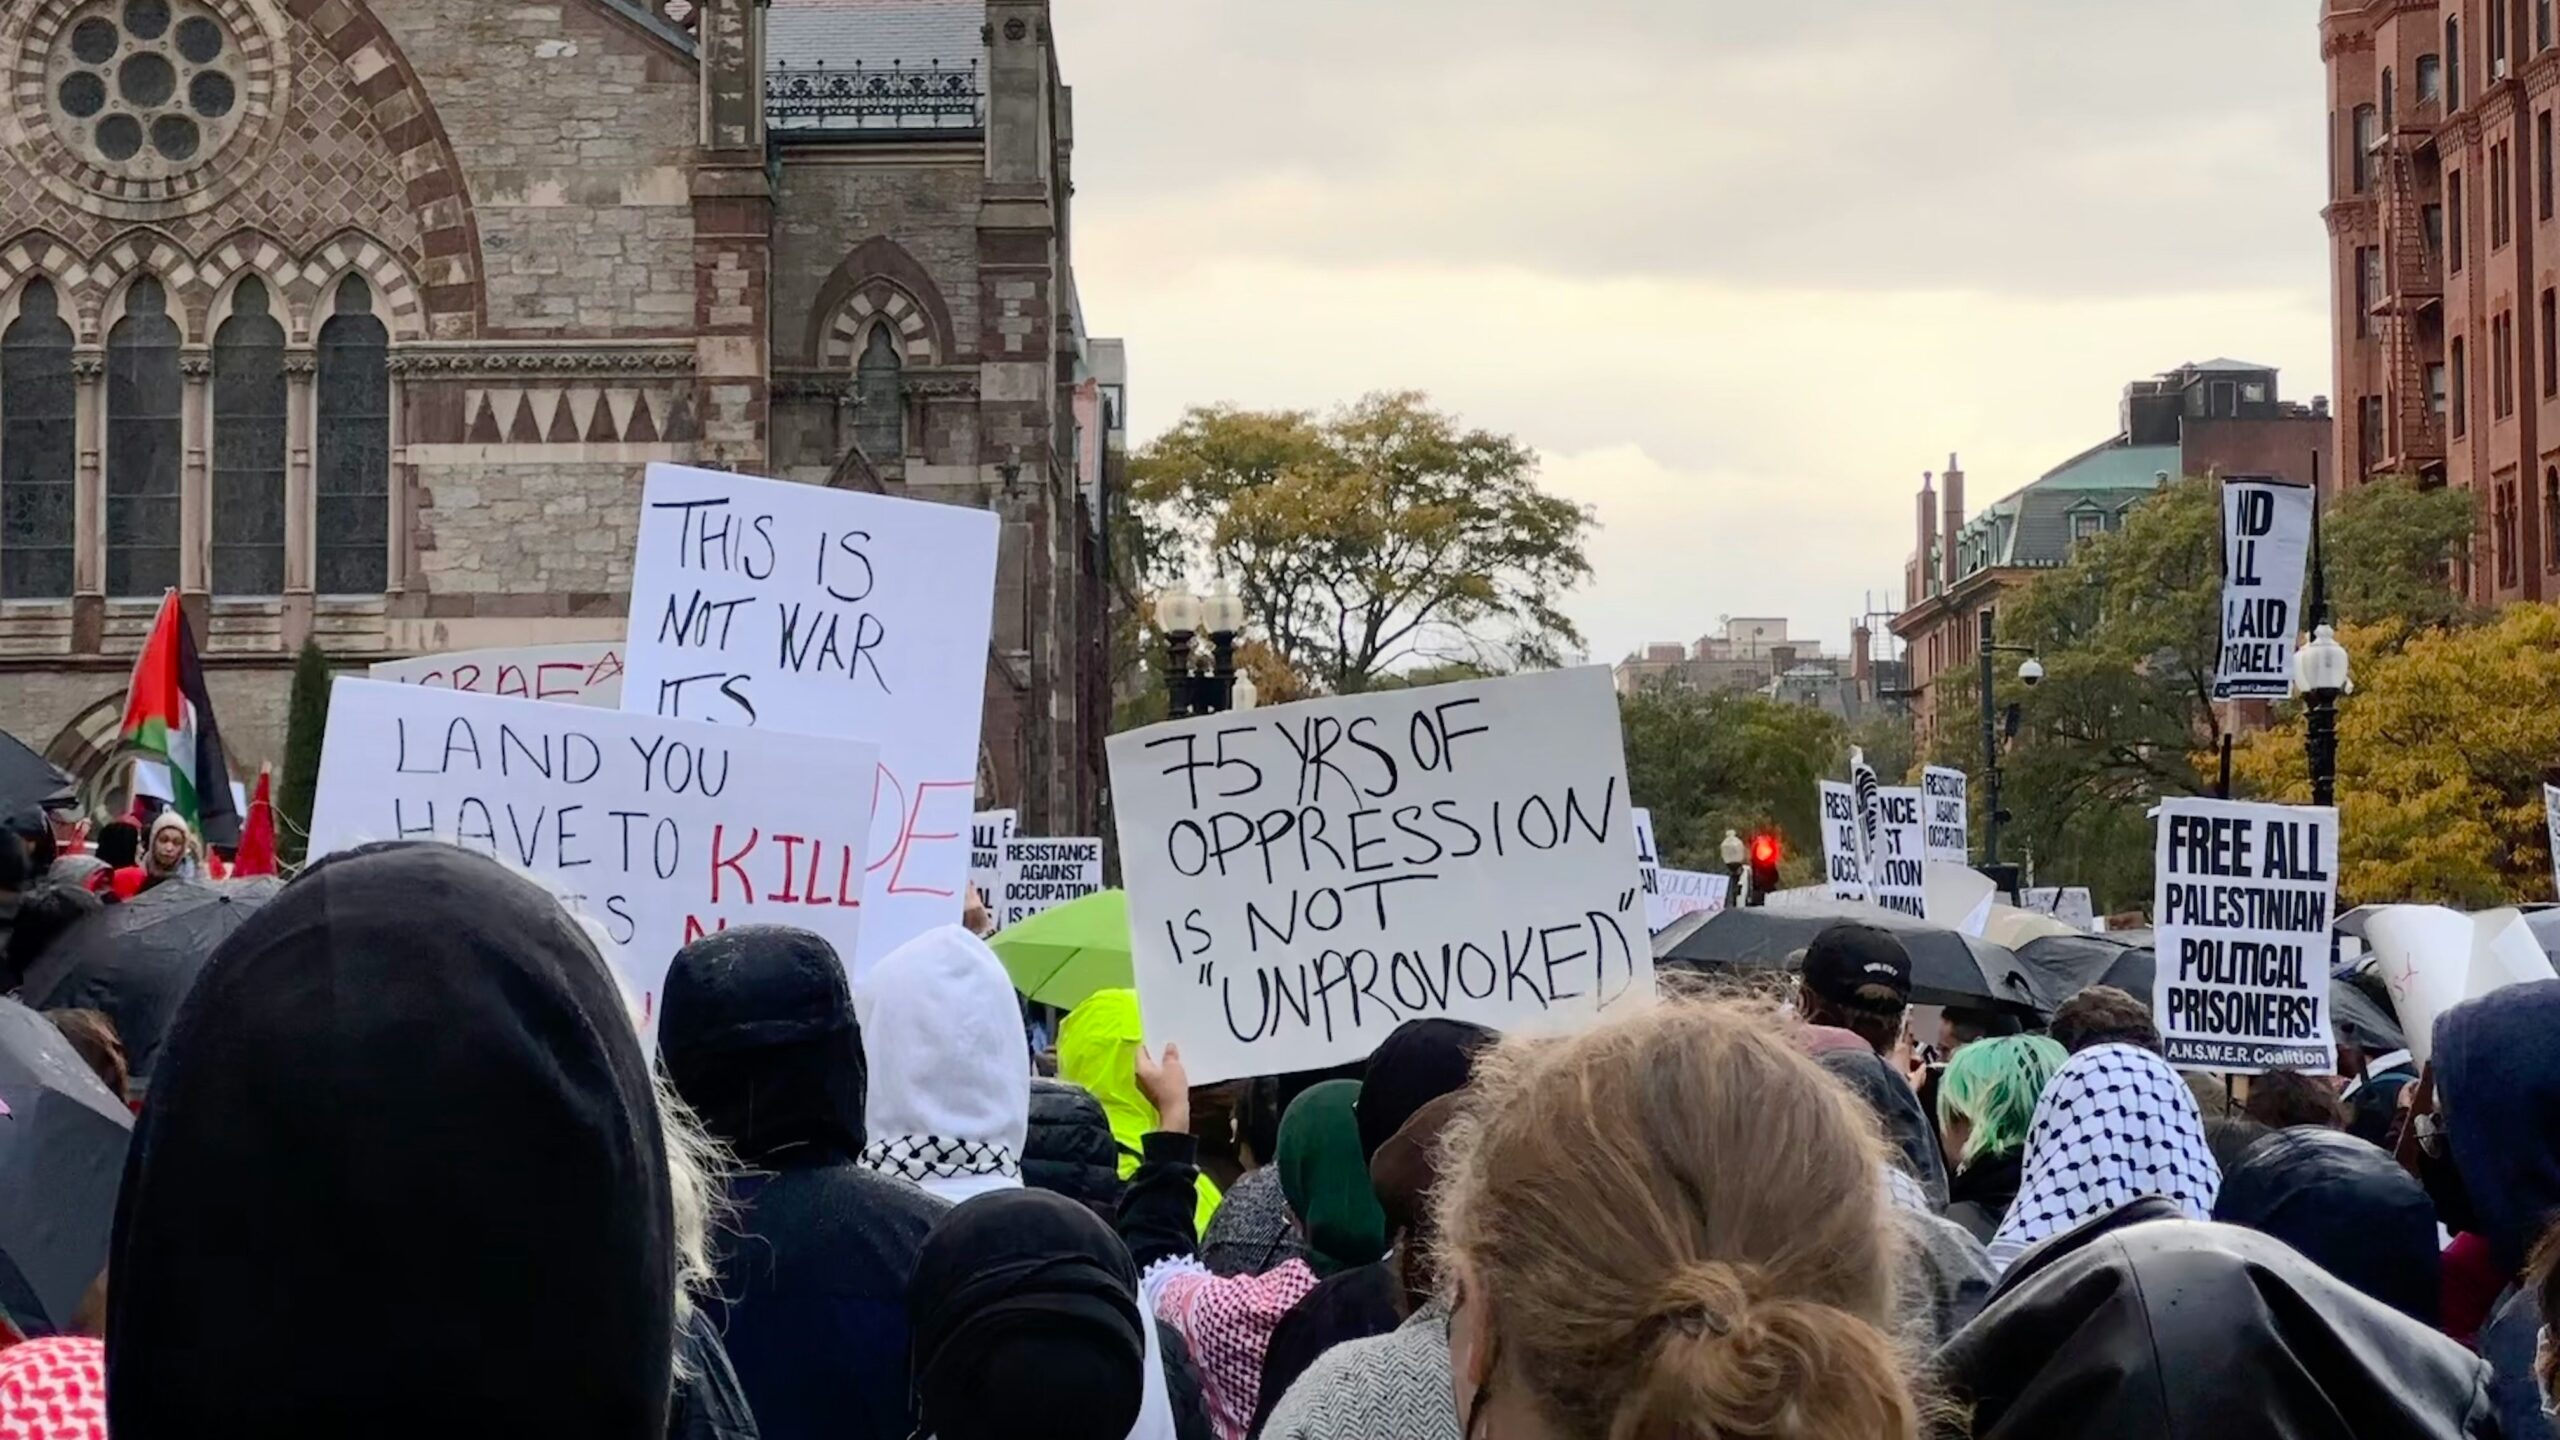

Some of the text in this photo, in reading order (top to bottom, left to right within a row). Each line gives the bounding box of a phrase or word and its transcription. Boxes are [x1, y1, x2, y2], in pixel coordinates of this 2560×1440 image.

[652, 497, 874, 602] THIS IS
[658, 588, 892, 695] NOT WAR
[396, 716, 728, 798] LAND YOU
[1145, 698, 1489, 809] 75 YRS OF
[394, 797, 861, 907] HAVE TO KILL
[1006, 844, 1098, 862] RESISTANCE
[1167, 776, 1615, 883] OPPRESSION
[2169, 814, 2328, 882] FREE ALL
[1020, 864, 1084, 881] AGAINST
[2166, 882, 2326, 933] PALESTINIAN
[1166, 874, 1439, 964] IS NOT
[1199, 888, 1635, 1043] "UNPROVOKED"
[2180, 938, 2308, 990] POLITICAL
[2167, 1042, 2326, 1066] A.N.S.W.E.R. Coalition
[2168, 988, 2321, 1039] PRISONERS!
